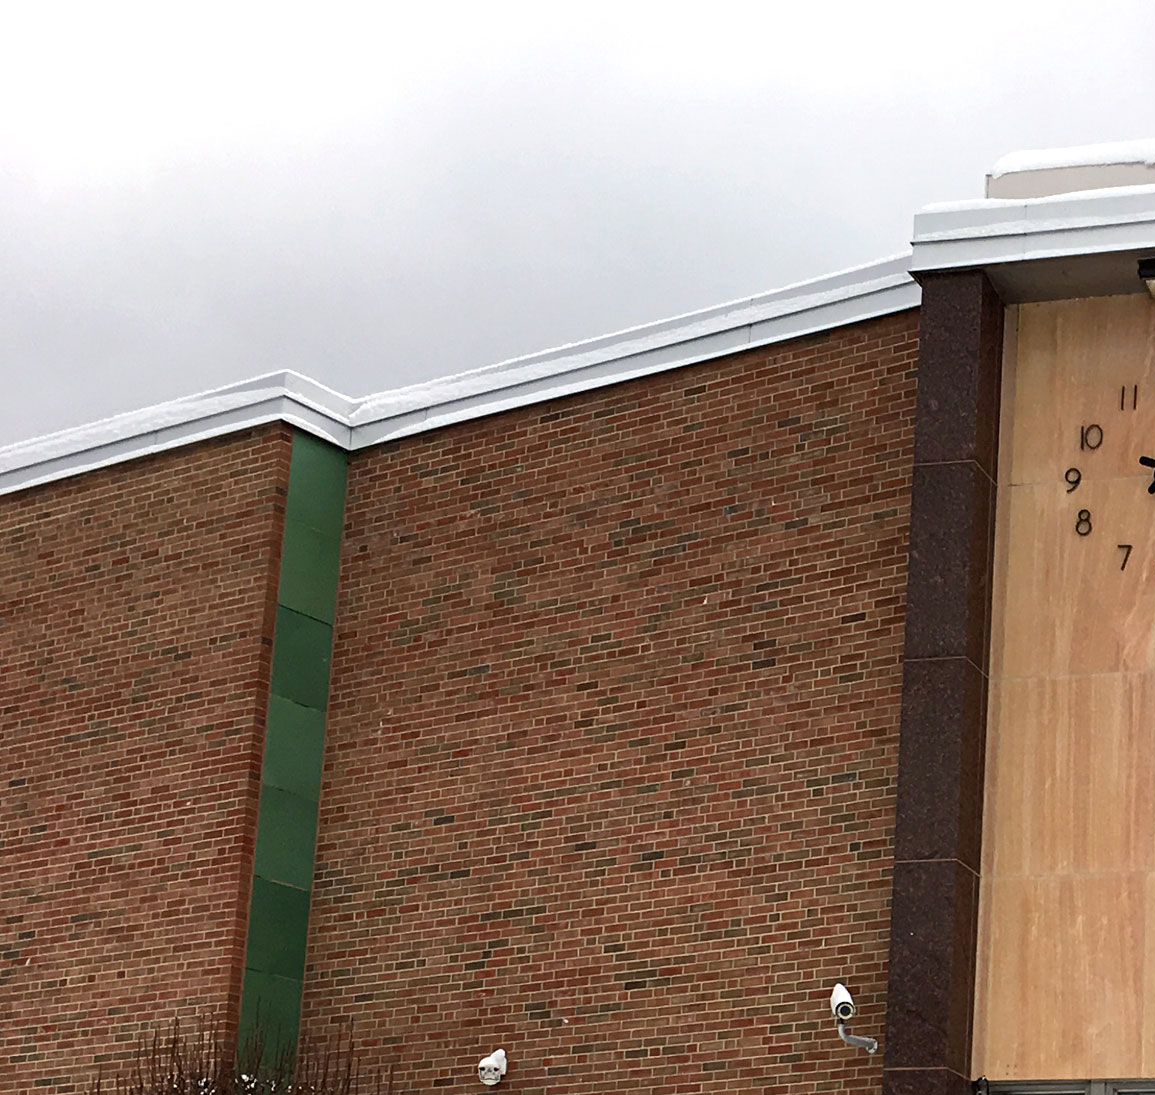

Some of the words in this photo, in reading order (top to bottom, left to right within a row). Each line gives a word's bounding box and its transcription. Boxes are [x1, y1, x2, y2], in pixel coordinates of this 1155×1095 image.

[1120, 384, 1138, 411] 11
[1080, 424, 1104, 451] 10
[1065, 467, 1082, 494] 9
[1075, 509, 1092, 536] 8
[1117, 544, 1133, 571] 7
